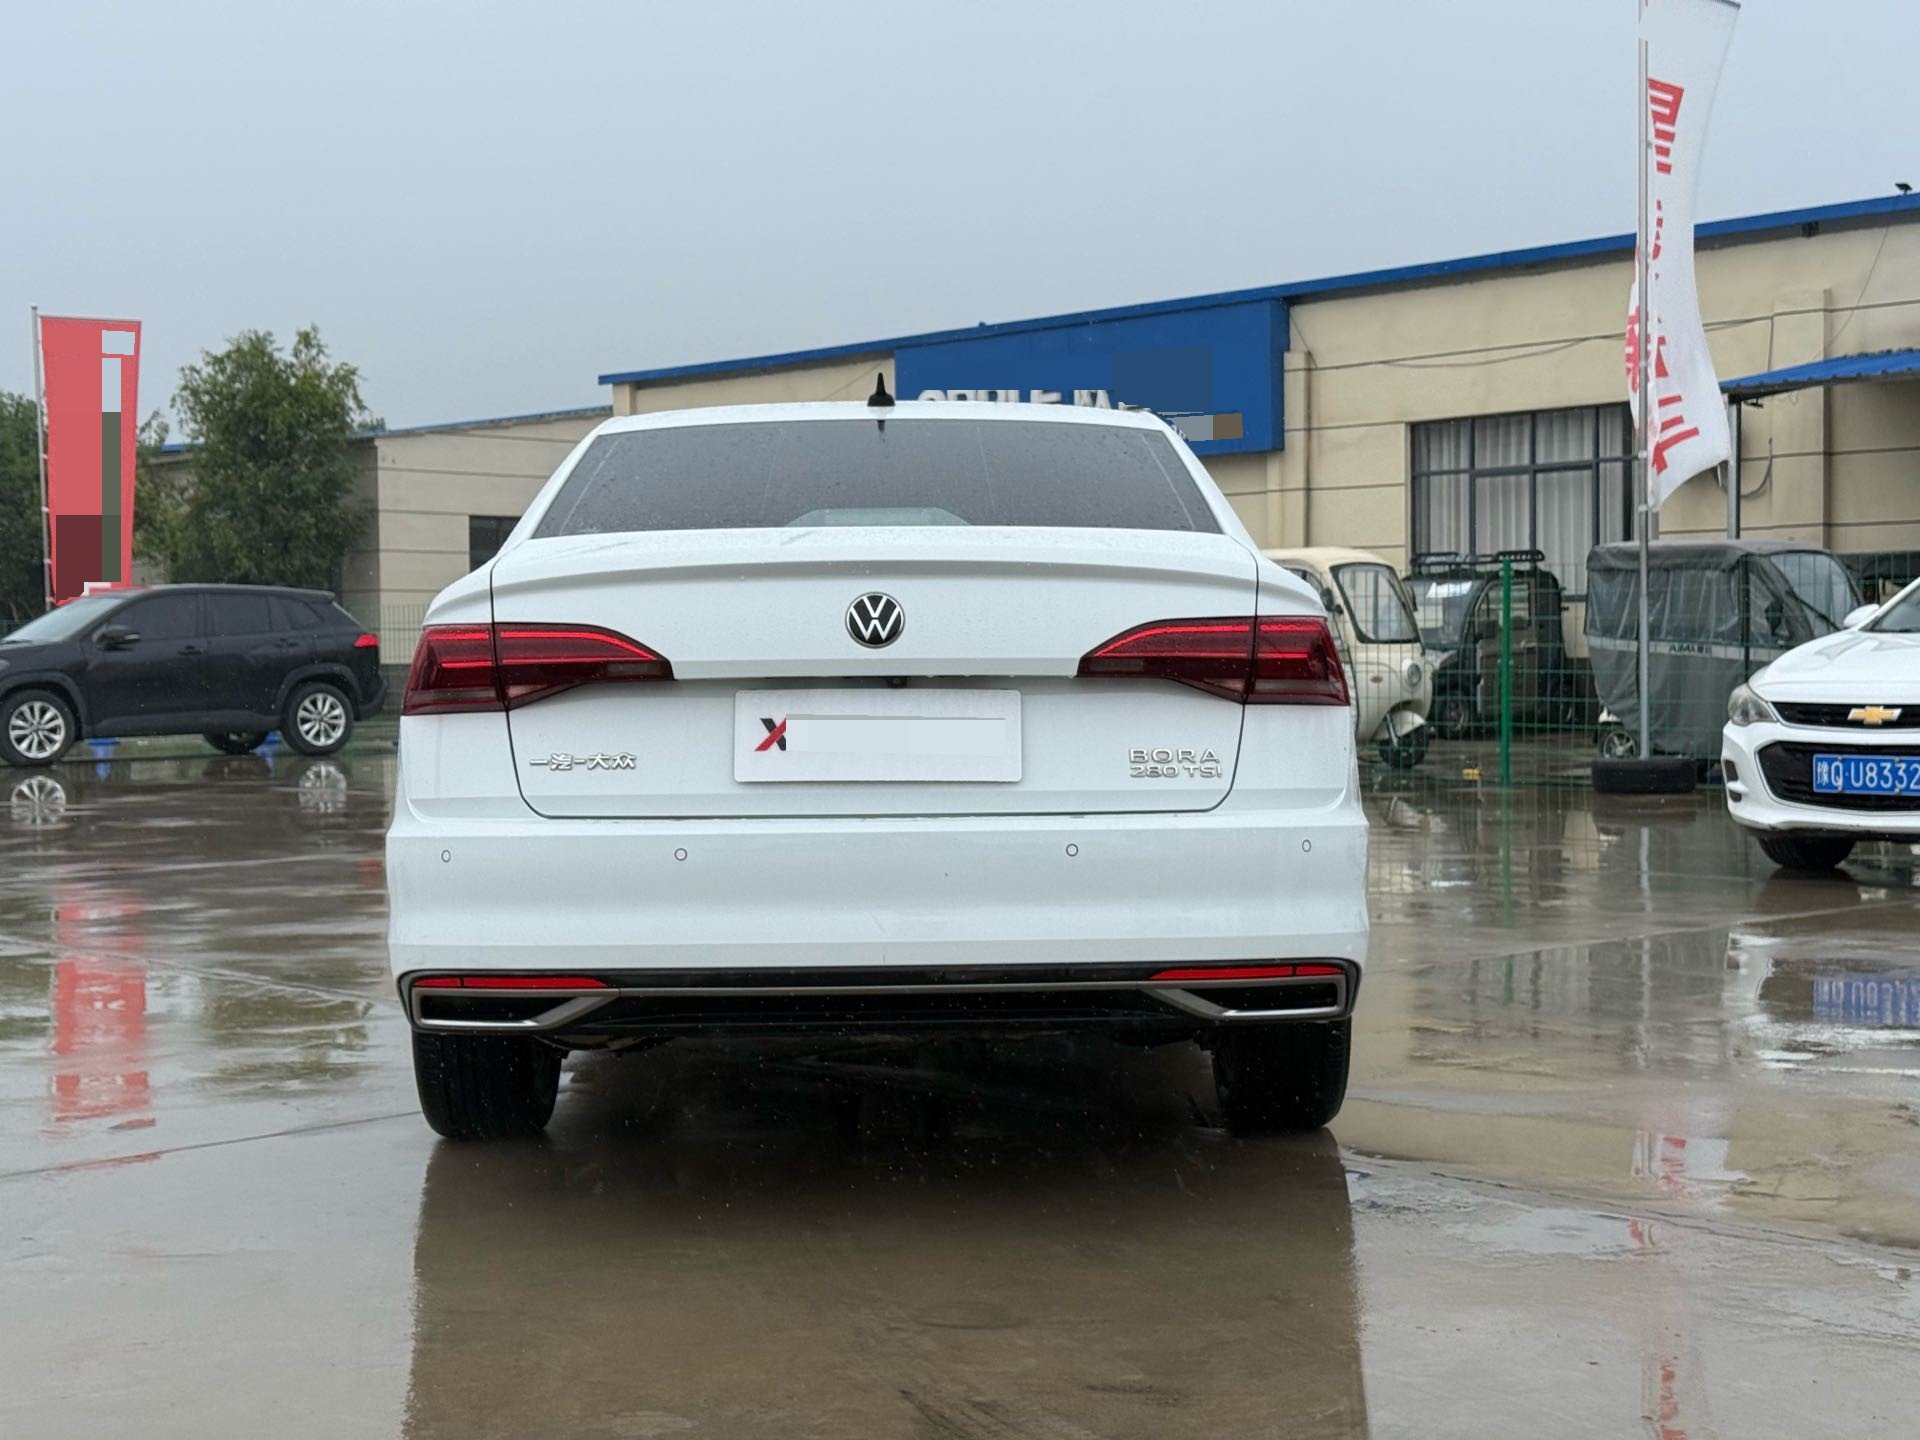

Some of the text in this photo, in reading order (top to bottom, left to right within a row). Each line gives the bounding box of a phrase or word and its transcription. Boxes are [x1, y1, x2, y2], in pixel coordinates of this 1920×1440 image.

[1128, 748, 1220, 764] BORA
[1129, 764, 1222, 778] 280 TSI
